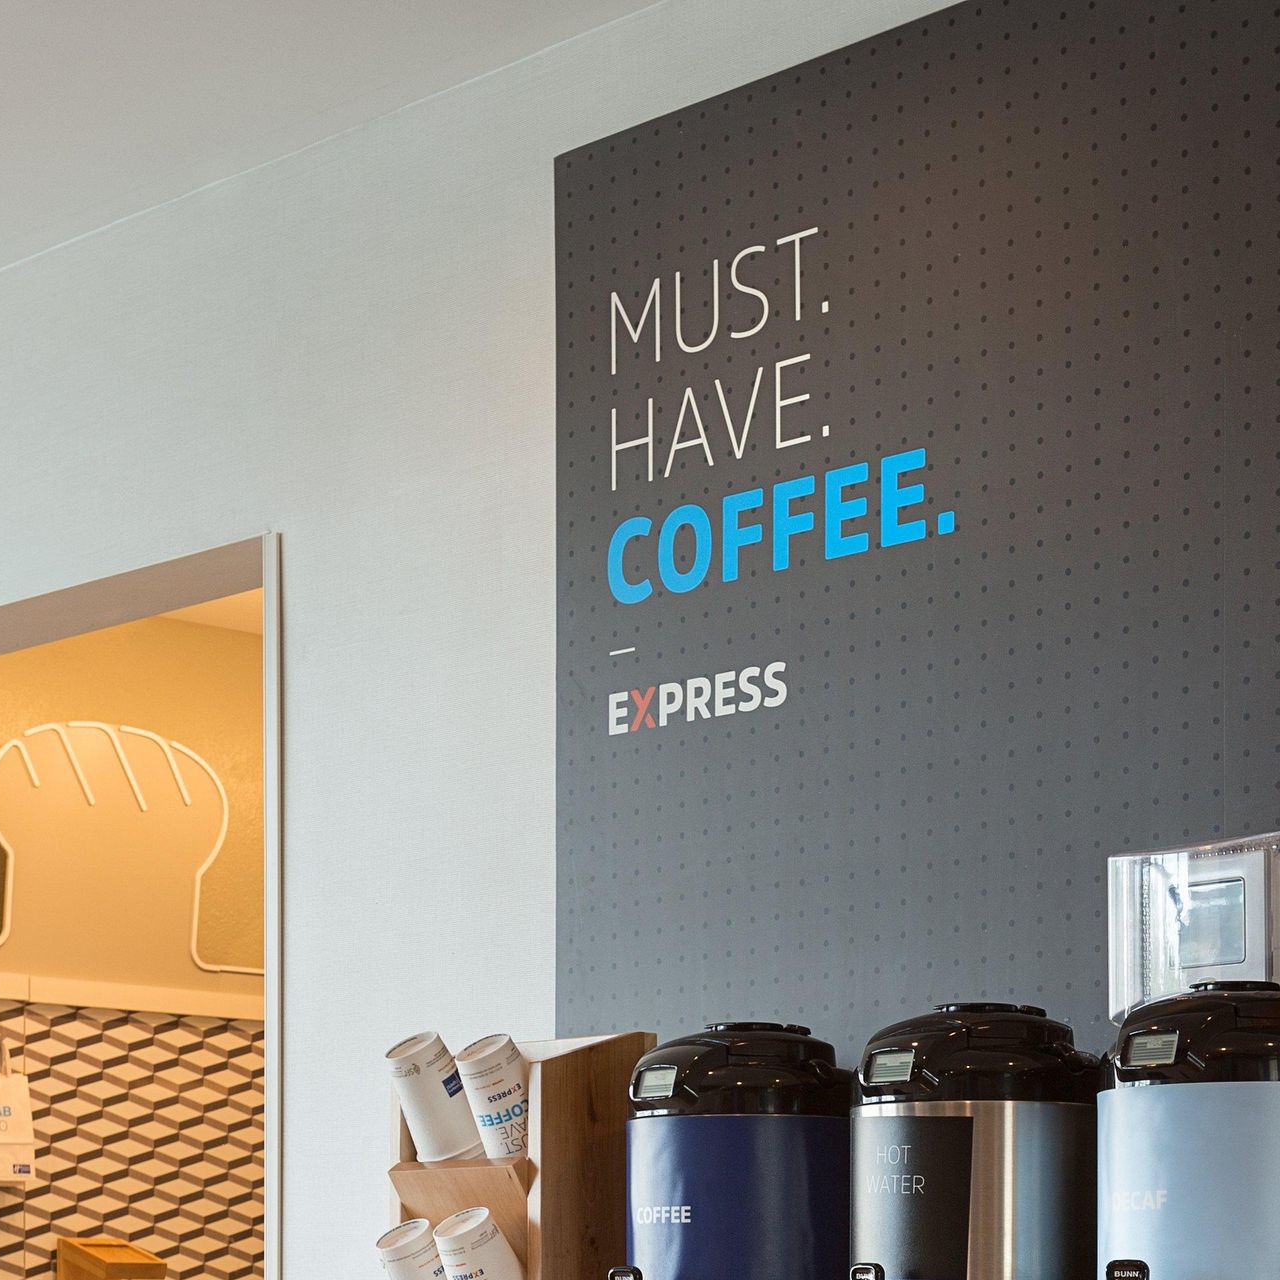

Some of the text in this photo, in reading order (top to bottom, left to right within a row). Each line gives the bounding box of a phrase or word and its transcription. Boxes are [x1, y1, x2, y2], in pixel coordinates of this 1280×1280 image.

[610, 226, 830, 376] MUST.
[610, 352, 830, 492] HAVE.
[607, 447, 956, 605] COFFEE.
[608, 661, 789, 737] EXPRESS
[487, 1082, 522, 1104] EXPRESS
[495, 1117, 528, 1140] AVE.
[500, 1134, 528, 1155] UST.
[876, 1145, 912, 1165] HOT
[865, 1174, 926, 1195] WATER
[636, 1205, 692, 1225] COFFEE
[1113, 1270, 1140, 1278] BUNN
